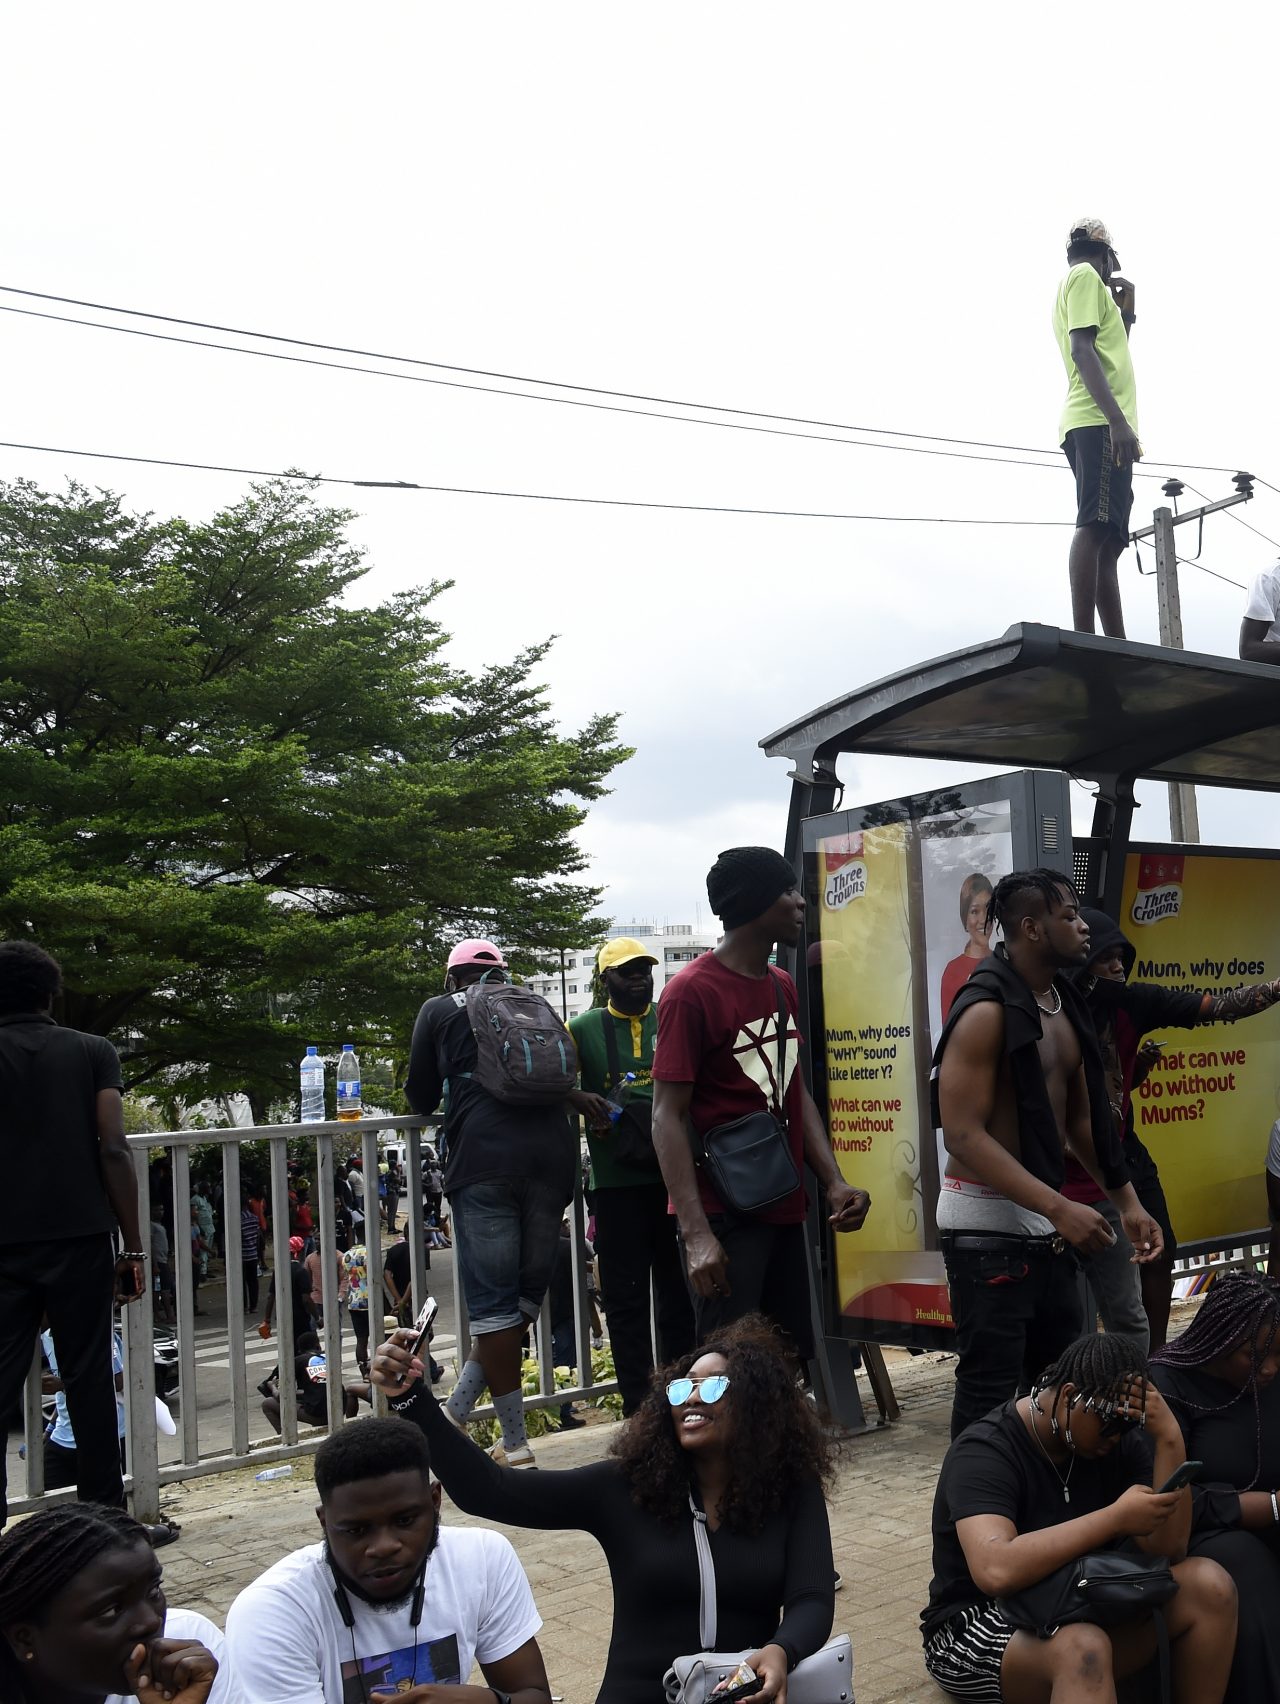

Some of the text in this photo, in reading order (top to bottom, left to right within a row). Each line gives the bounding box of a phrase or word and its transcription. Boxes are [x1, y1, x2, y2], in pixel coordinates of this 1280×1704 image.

[833, 867, 863, 893] Three
[826, 880, 865, 906] Crowns
[1143, 891, 1178, 909] Three
[1133, 902, 1179, 921] Crowns
[1137, 957, 1265, 980] Mum, why does
[826, 1024, 911, 1042] Mum, why does
[1149, 1049, 1246, 1072] hat can we
[828, 1064, 893, 1081] like letter Y?
[1139, 1072, 1236, 1099] do without
[830, 1098, 901, 1112] What can we
[1141, 1099, 1205, 1125] Mums?
[831, 1116, 894, 1132] do without
[832, 1136, 873, 1152] Mums?
[915, 1308, 945, 1324] Healthy
